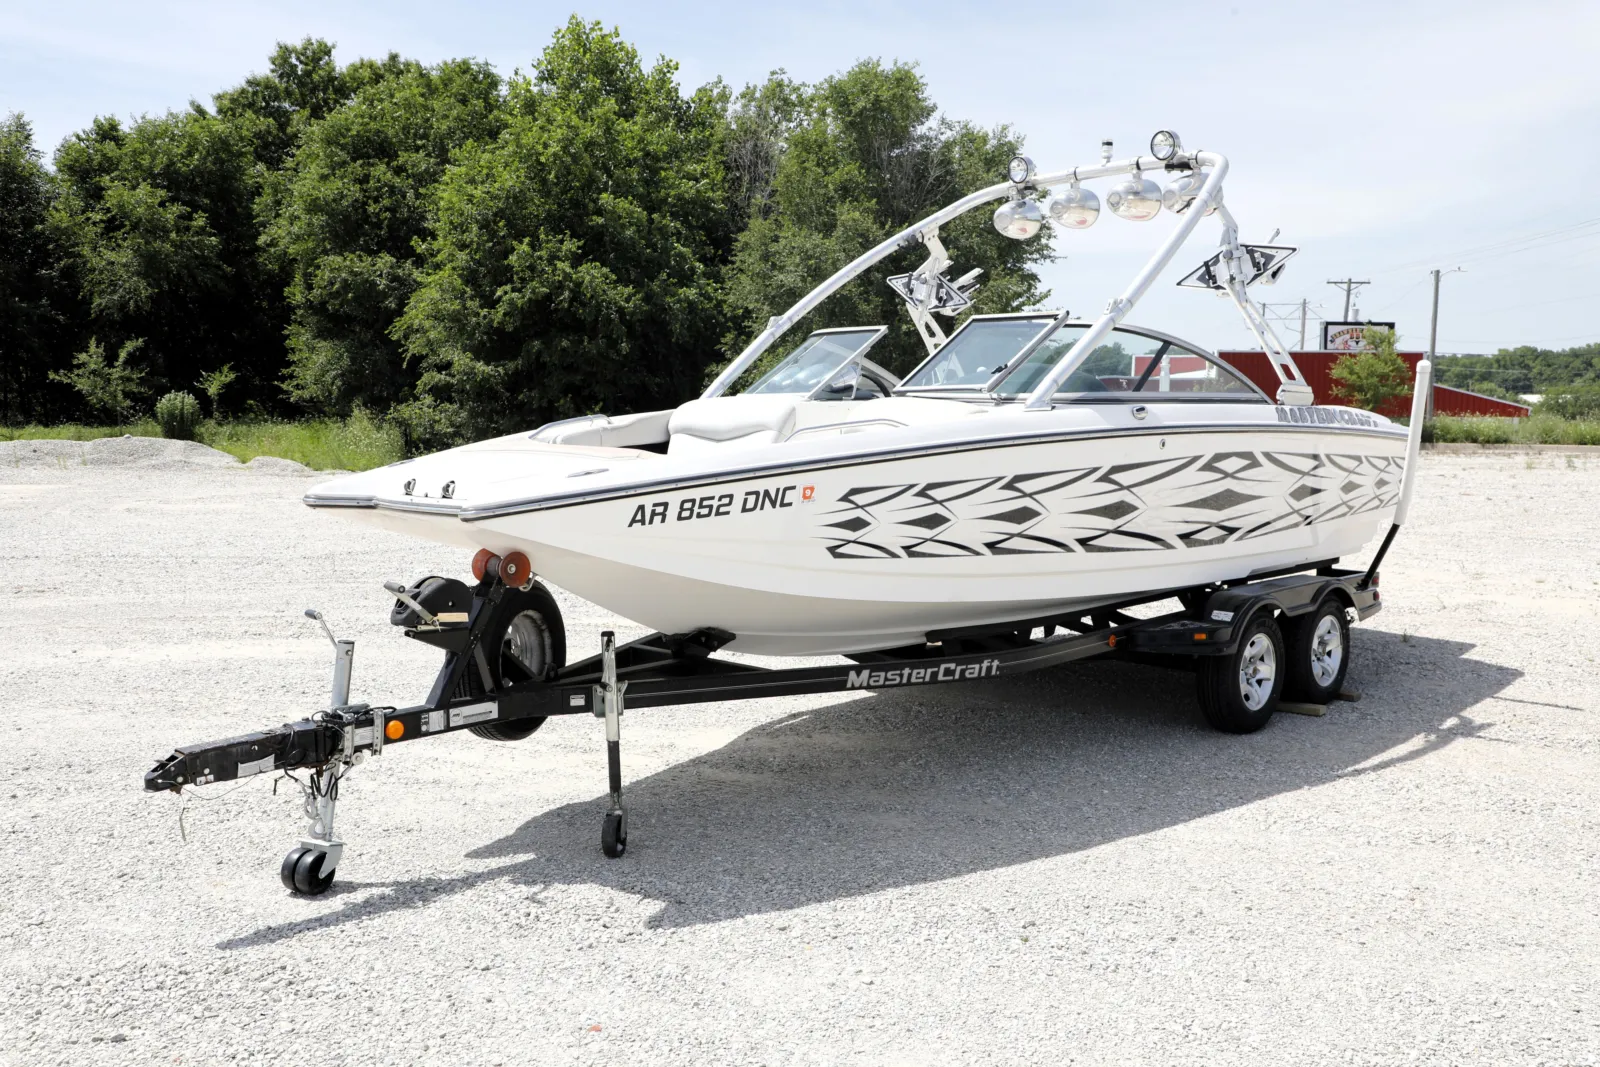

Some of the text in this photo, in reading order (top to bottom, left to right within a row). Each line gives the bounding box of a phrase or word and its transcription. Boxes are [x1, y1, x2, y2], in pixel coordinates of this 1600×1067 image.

[628, 485, 797, 527] AR 852 DNC
